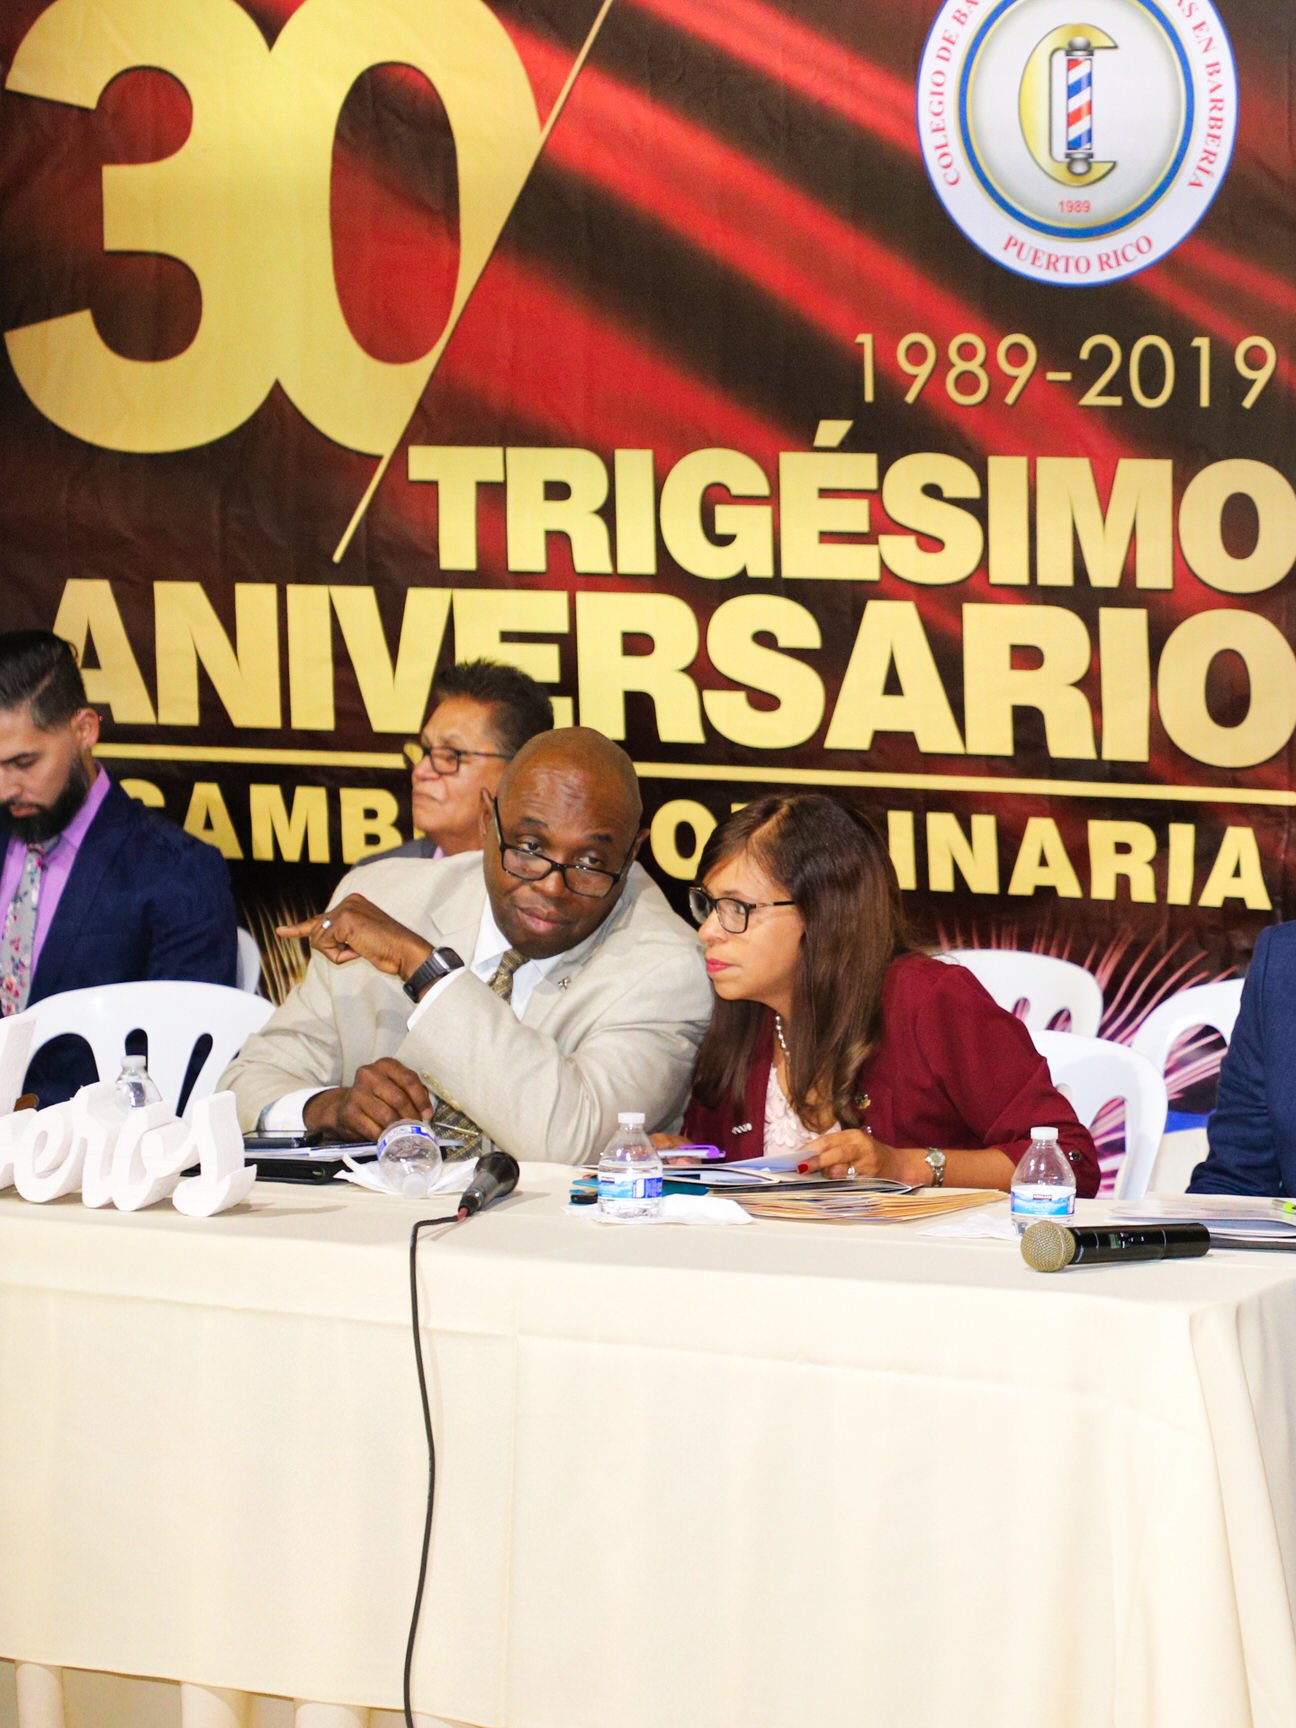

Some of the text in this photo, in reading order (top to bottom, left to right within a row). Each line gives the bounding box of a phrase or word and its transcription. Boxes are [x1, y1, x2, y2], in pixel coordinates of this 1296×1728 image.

[934, 29, 959, 63] DE
[1192, 20, 1216, 54] EN
[929, 69, 960, 188] COLEGIO
[1188, 60, 1225, 190] BARBERÍA
[3, 0, 541, 456] 30
[1058, 200, 1091, 214] 1989
[1002, 233, 1153, 274] PUERTO RICO
[854, 332, 1278, 410] 1989-2019
[650, 799, 1272, 910] OINARIA
